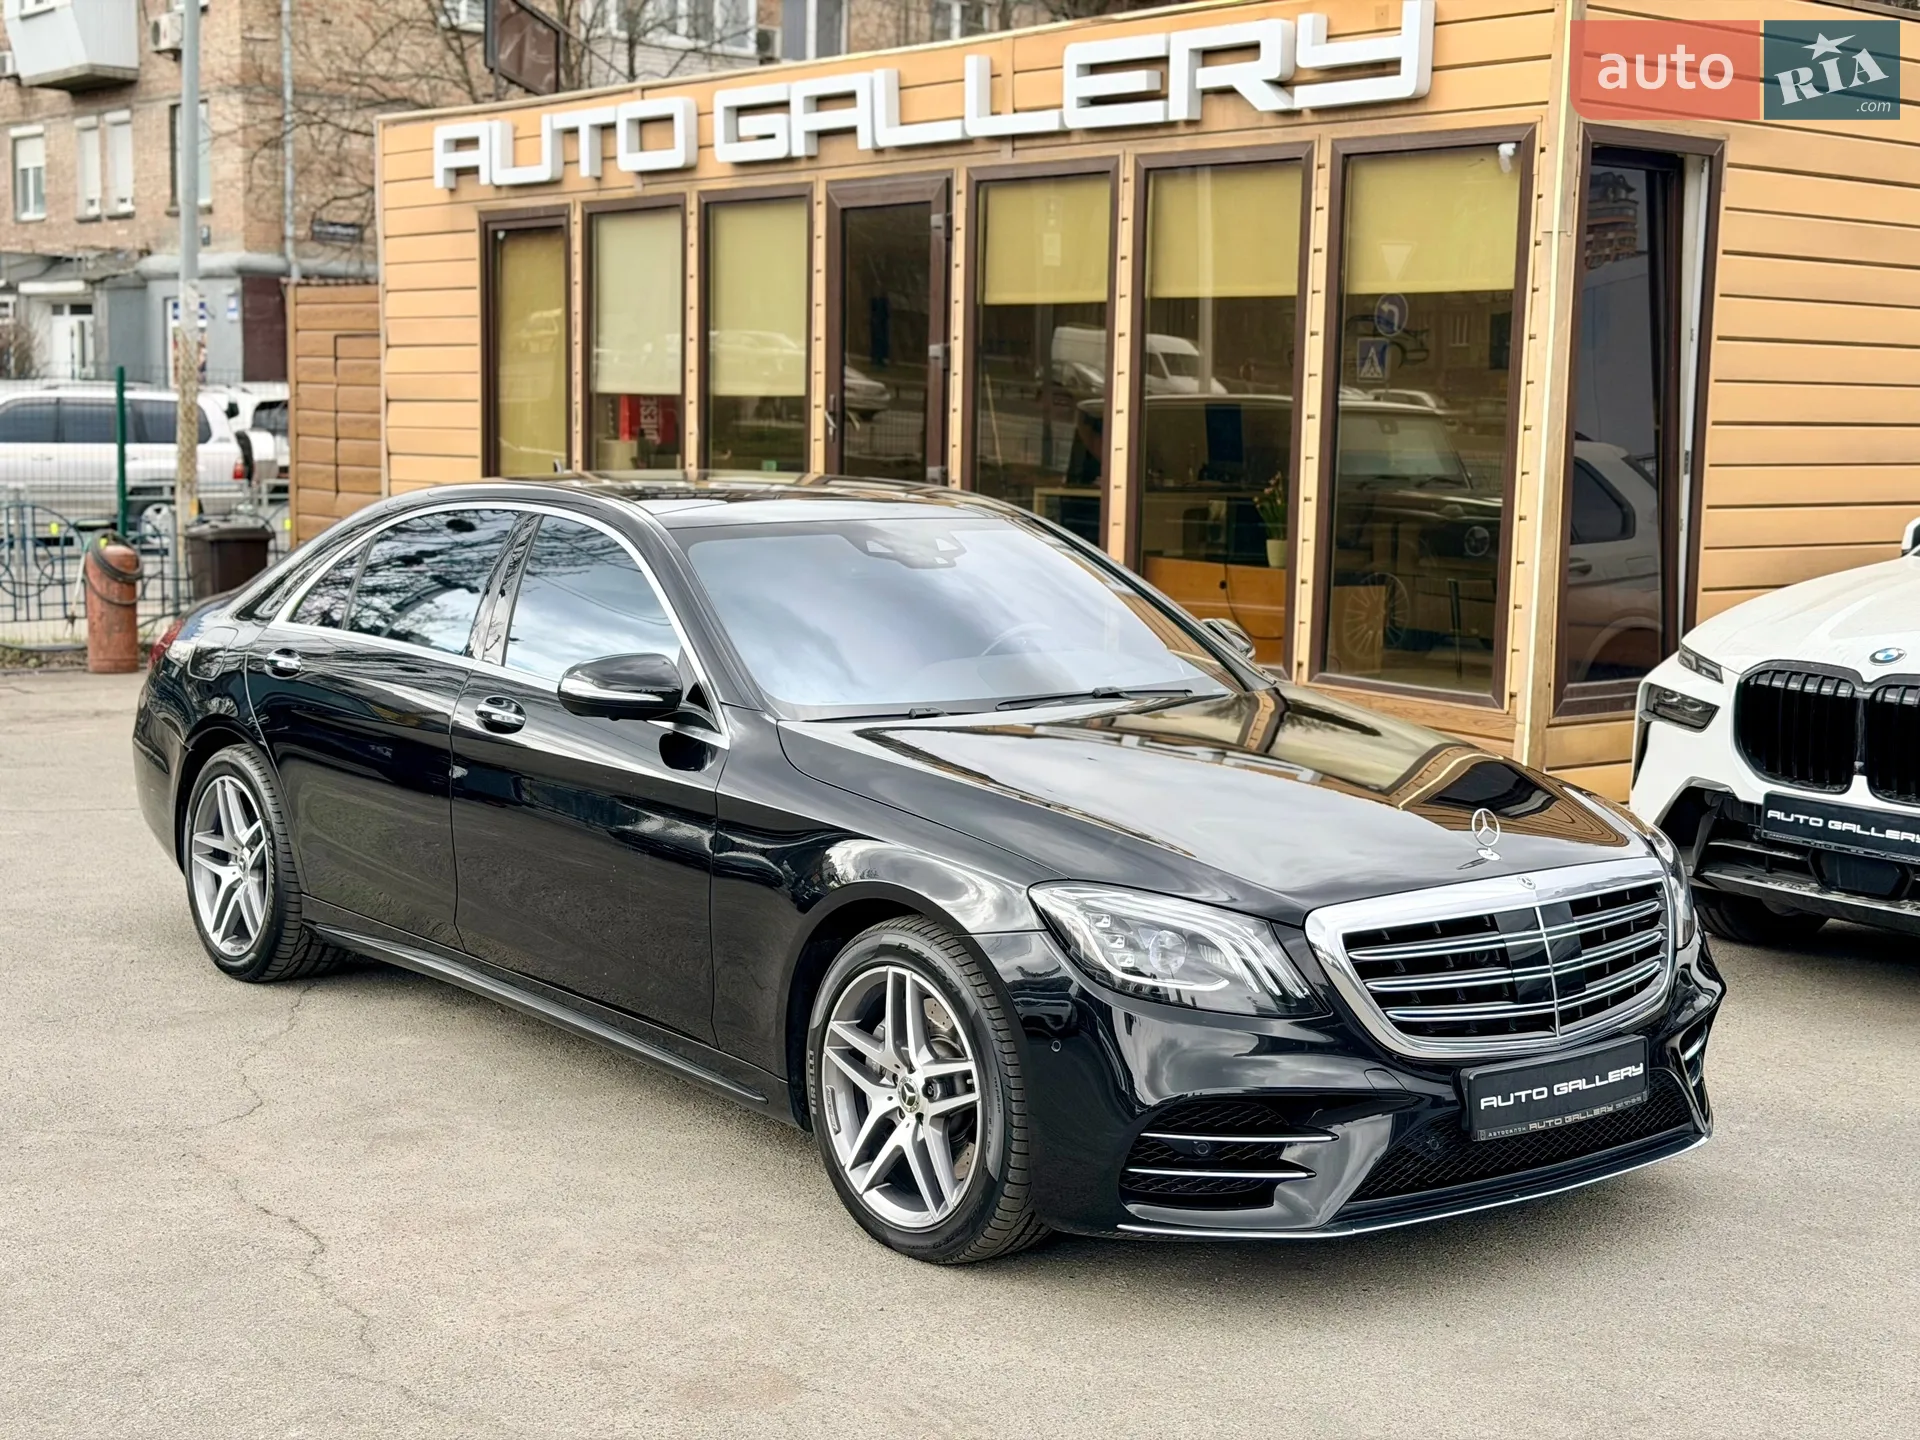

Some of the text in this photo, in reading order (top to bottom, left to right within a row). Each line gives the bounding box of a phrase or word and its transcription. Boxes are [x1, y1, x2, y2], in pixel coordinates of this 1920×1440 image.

[433, 0, 1436, 189] AUTO GALLERY
[639, 395, 659, 441] DIESE
[1767, 810, 1824, 827] AUTO
[1480, 1062, 1644, 1110] AUTO GALLERY
[1528, 1104, 1614, 1131] AUTO GALLERY
